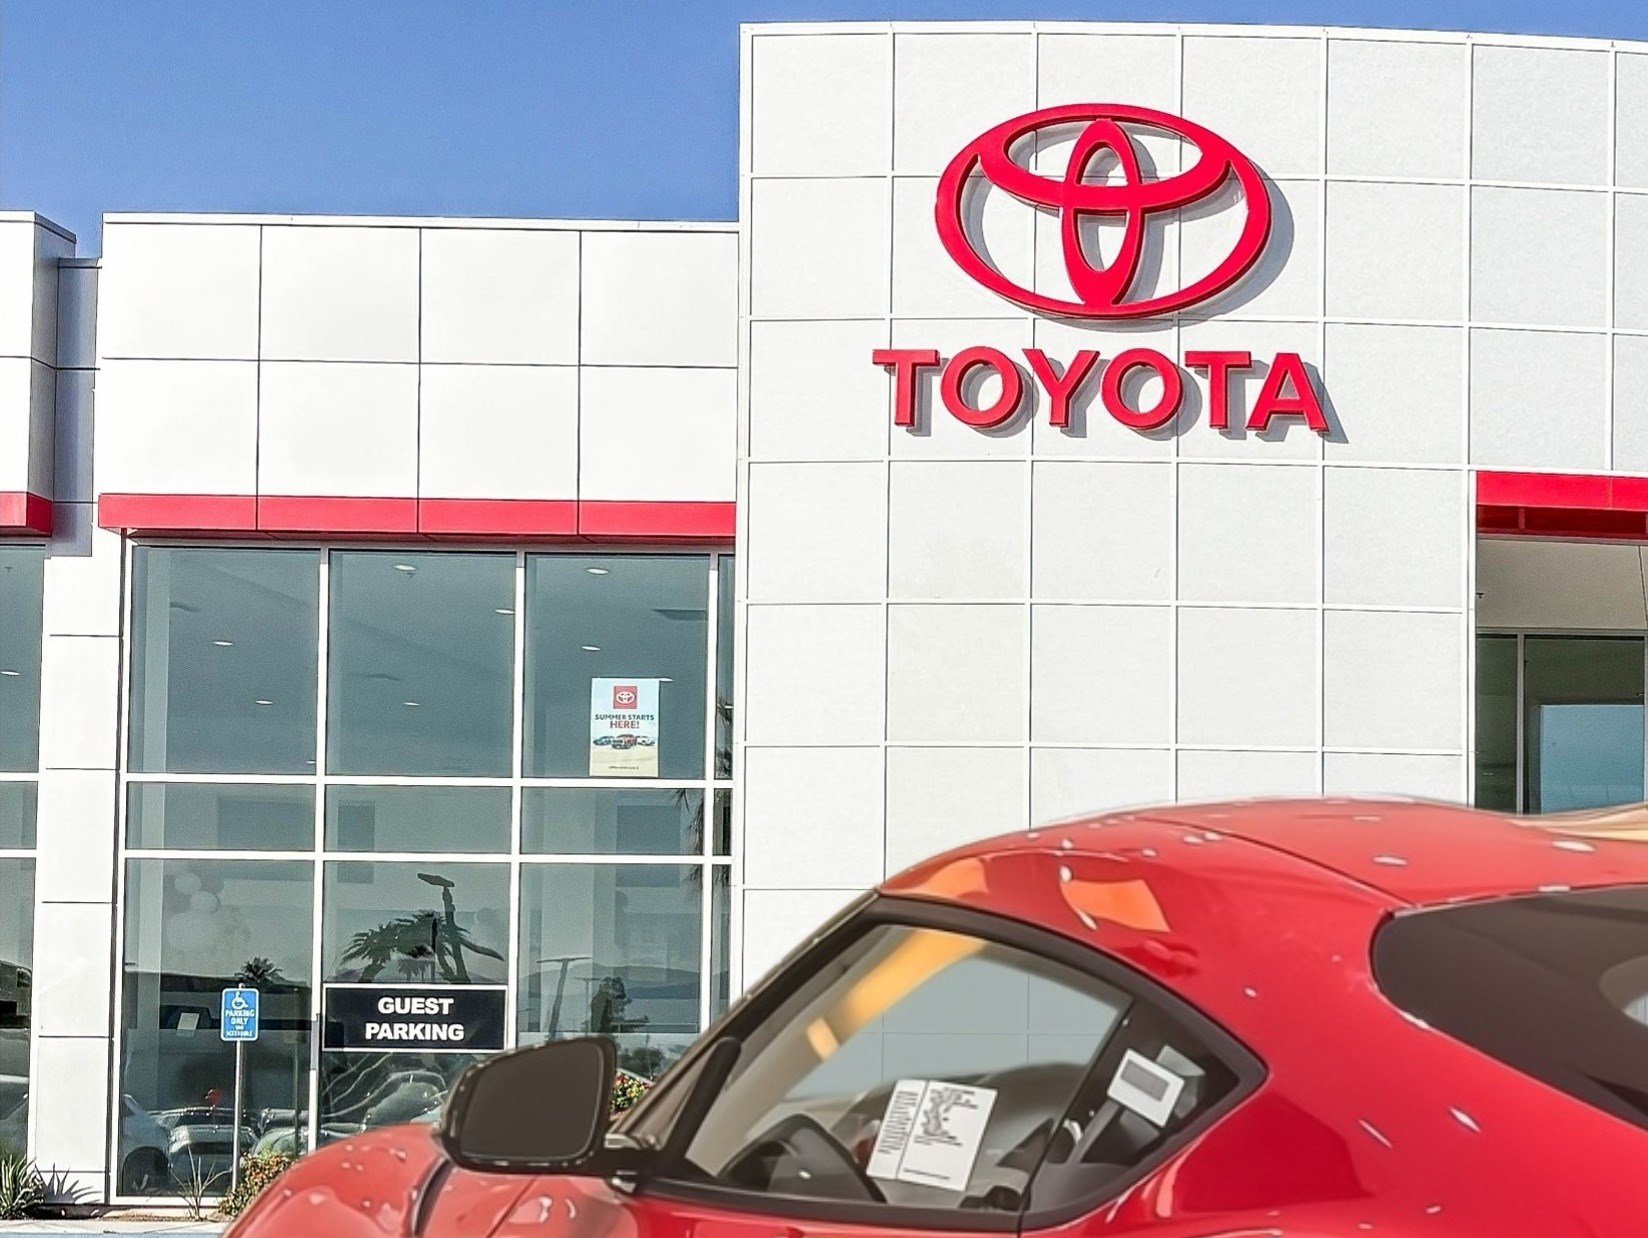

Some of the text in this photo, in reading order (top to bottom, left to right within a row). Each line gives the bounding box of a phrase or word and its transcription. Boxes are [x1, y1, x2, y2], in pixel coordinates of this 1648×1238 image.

[873, 345, 1330, 432] TOYOTA
[609, 721, 640, 729] HERE!
[377, 997, 454, 1015] GUEST
[364, 1023, 465, 1041] PARKING
